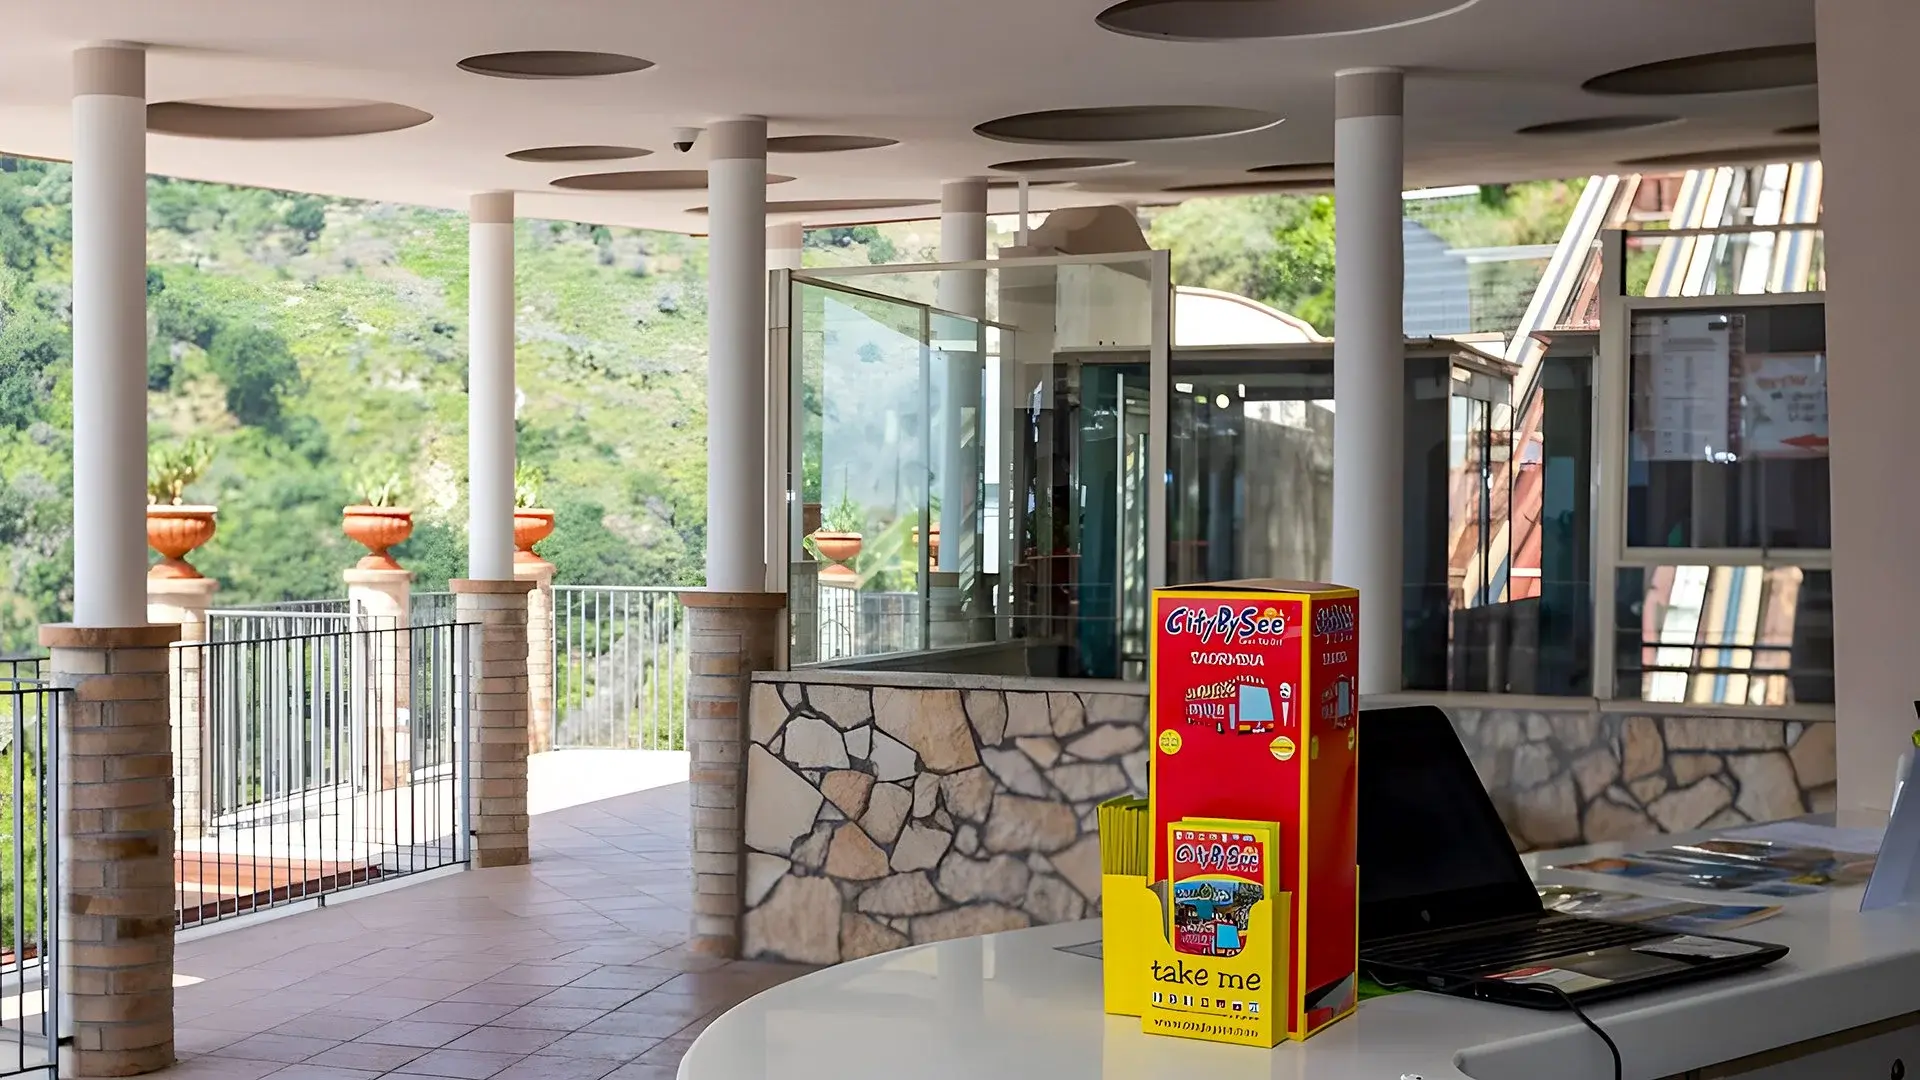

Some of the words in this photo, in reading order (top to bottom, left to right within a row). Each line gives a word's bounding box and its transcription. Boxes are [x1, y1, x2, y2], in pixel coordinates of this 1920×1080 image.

[1165, 605, 1284, 644] CityBySee
[1151, 960, 1209, 986] take
[1217, 972, 1261, 991] me
